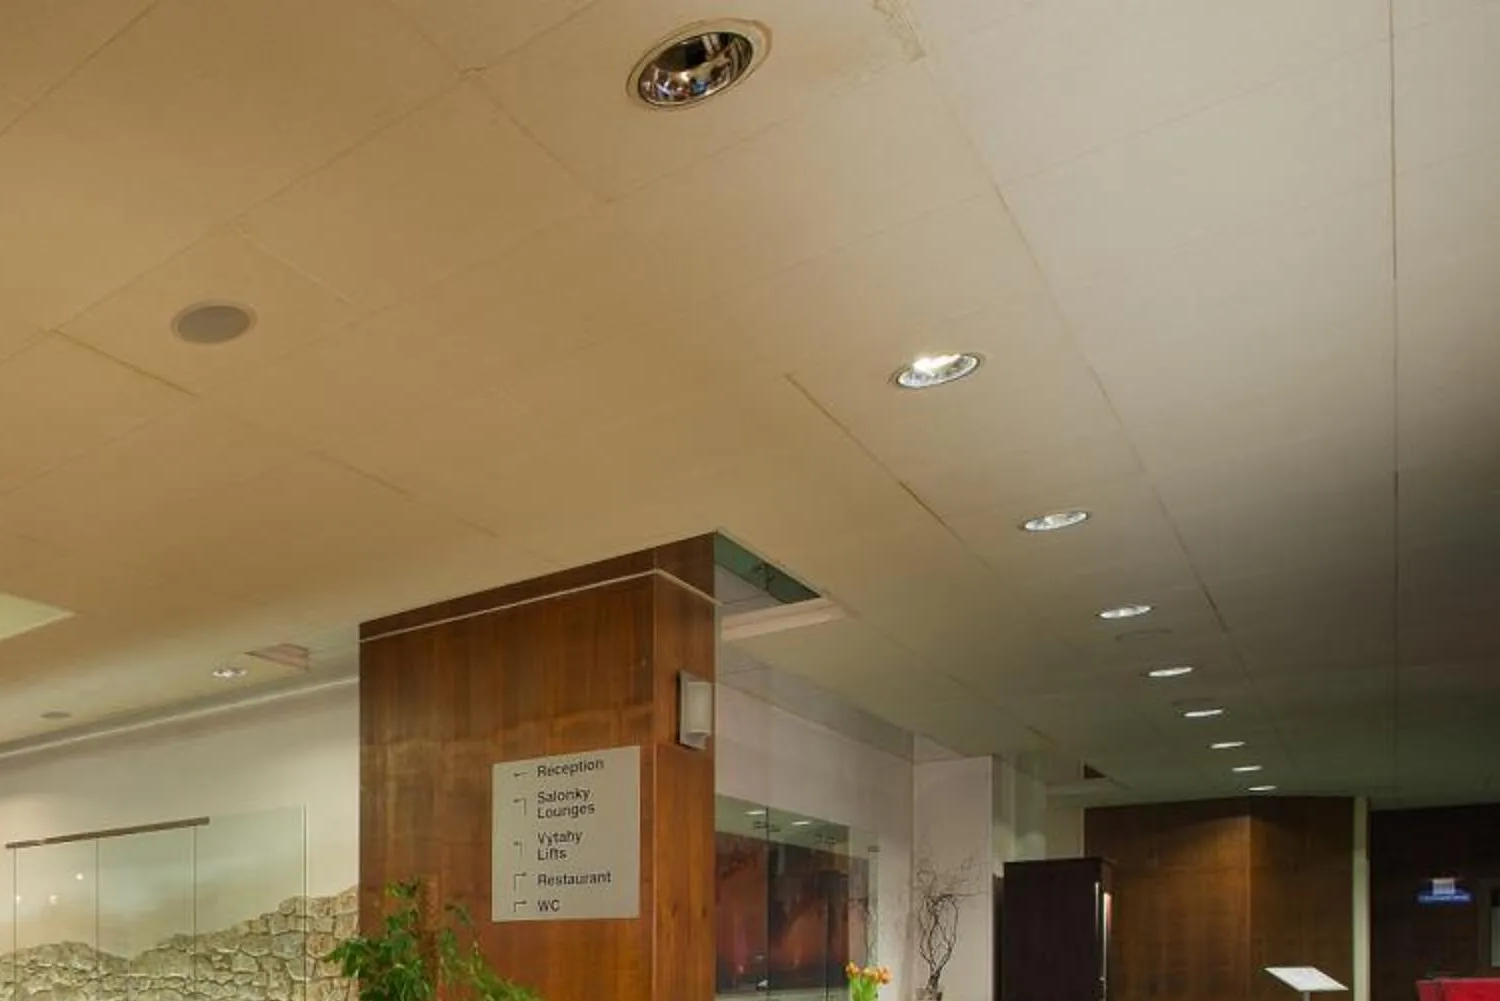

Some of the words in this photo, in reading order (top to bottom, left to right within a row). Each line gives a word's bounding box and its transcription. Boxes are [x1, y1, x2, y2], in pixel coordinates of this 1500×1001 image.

[537, 759, 604, 777] Reception
[537, 788, 591, 804] Salonky
[537, 803, 595, 819] Lounges
[537, 848, 567, 861] Lifts
[537, 870, 612, 887] Restaurant
[537, 899, 560, 912] WC
